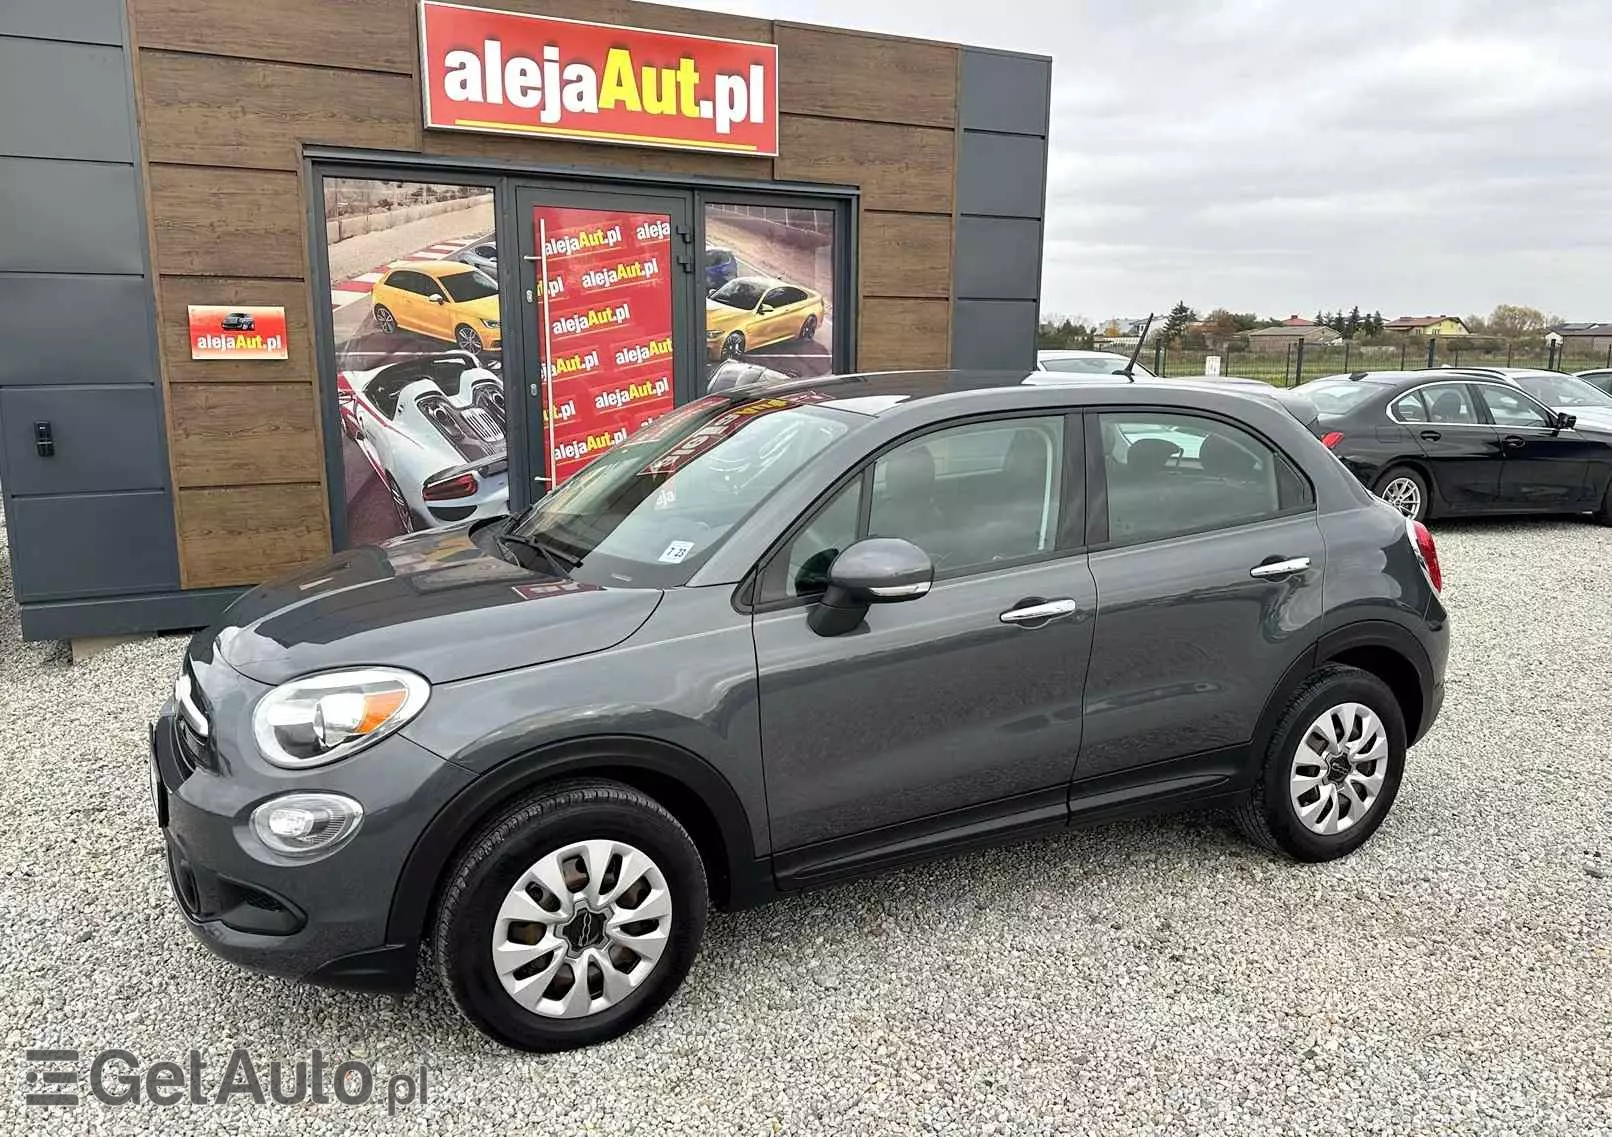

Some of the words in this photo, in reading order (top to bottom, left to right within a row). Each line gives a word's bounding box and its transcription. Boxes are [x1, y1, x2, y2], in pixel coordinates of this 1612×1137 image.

[444, 39, 764, 134] alejaAut.pl
[544, 226, 622, 255] alejaAut.pl
[582, 258, 659, 288] alejaAut.pl
[552, 304, 630, 334] alejaAut.pl
[197, 334, 281, 352] alejaAut.pl
[595, 377, 669, 408] alejaAut.pl
[554, 428, 627, 460] alejaAut.pl
